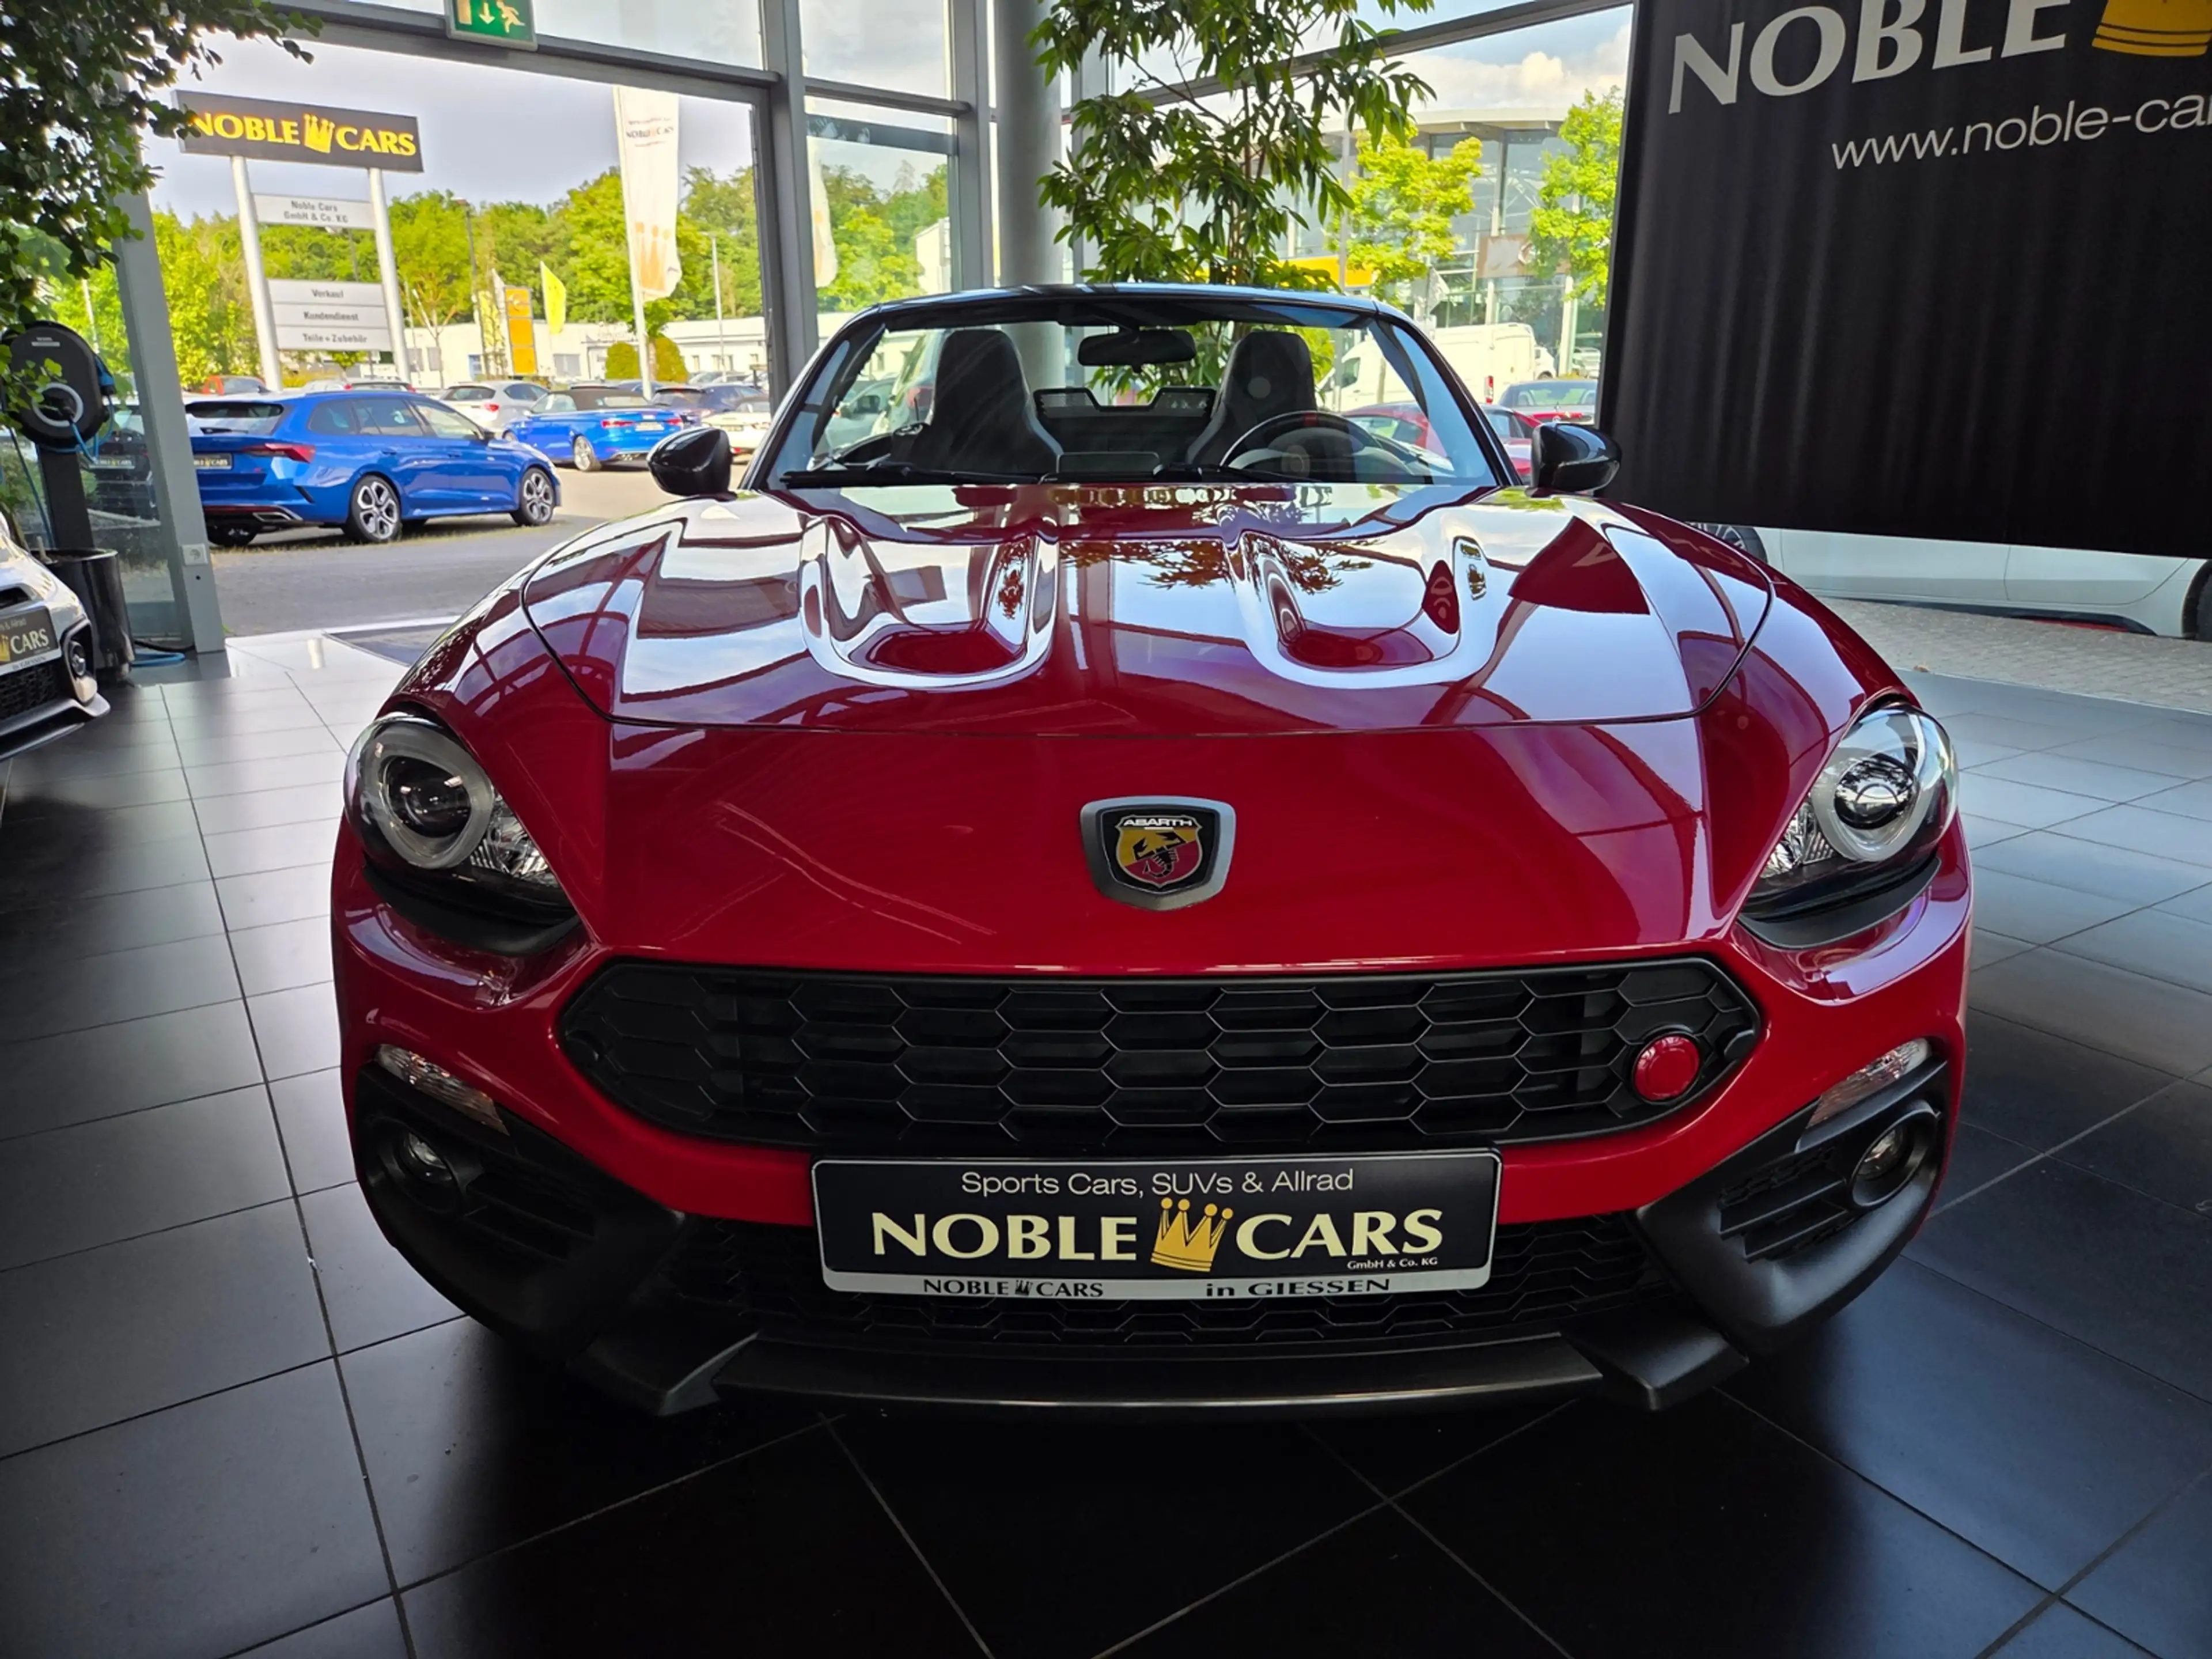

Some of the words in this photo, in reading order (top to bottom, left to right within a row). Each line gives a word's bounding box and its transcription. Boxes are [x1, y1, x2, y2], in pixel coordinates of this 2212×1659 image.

[1668, 0, 2072, 114] NOBLE
[192, 112, 301, 145] NOBLE
[336, 126, 416, 156] CARS
[10, 628, 50, 654] CARS
[1123, 818, 1193, 826] ABARTH
[961, 1172, 1060, 1197] Sports
[1067, 1173, 1145, 1198] Cars,
[1152, 1172, 1233, 1195] SUVs
[1241, 1172, 1264, 1193] &
[1271, 1168, 1354, 1192] Allrad
[872, 1212, 1138, 1260] NOBLE
[1236, 1208, 1444, 1260] CARS
[1347, 1259, 1384, 1270] GmbH
[1387, 1259, 1396, 1268] &
[1399, 1257, 1419, 1267] Co.
[1421, 1256, 1438, 1266] KG
[923, 1279, 1009, 1296] NOBLE
[1036, 1282, 1103, 1297] CARS
[1206, 1282, 1235, 1297] in
[1248, 1278, 1391, 1297] GIESSEN
